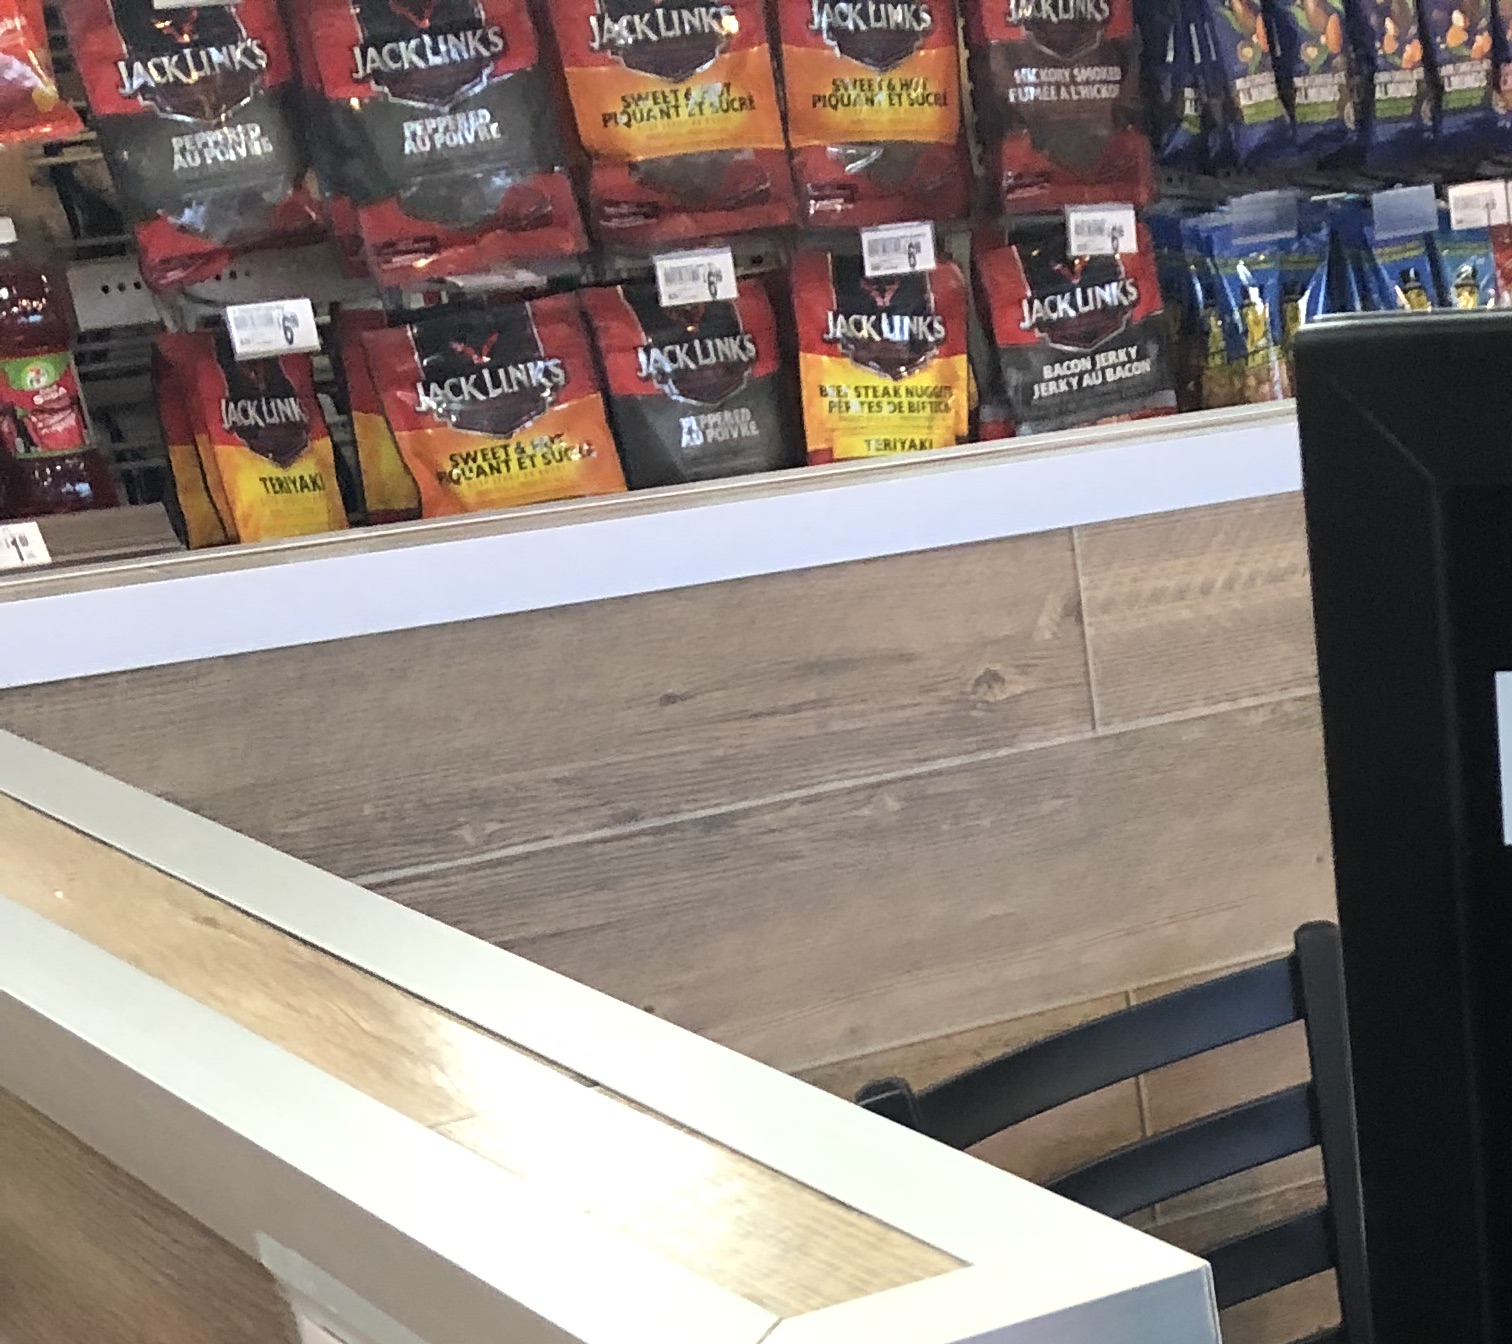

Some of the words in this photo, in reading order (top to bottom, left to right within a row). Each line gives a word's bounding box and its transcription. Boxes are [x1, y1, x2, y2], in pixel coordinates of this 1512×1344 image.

[588, 12, 659, 50] JACK
[808, 0, 868, 31] JACK
[352, 37, 428, 79] JACK
[117, 55, 198, 96] JACK
[823, 310, 882, 341] JACK
[1019, 291, 1078, 330] JACK
[637, 342, 697, 378] JACK
[1042, 355, 1092, 380] BACON
[1094, 345, 1139, 368] JERKY
[415, 374, 487, 412] JACK
[853, 384, 901, 400] STEAK
[1033, 375, 1080, 400] JERKY
[1082, 371, 1103, 388] AU
[1105, 358, 1151, 383] BACON
[220, 398, 266, 430] JACK
[886, 399, 906, 414] DE
[448, 442, 511, 470] SWEET
[863, 437, 934, 452] TERIYAKI
[517, 453, 537, 471] ET
[259, 471, 325, 496] TERIYAKI
